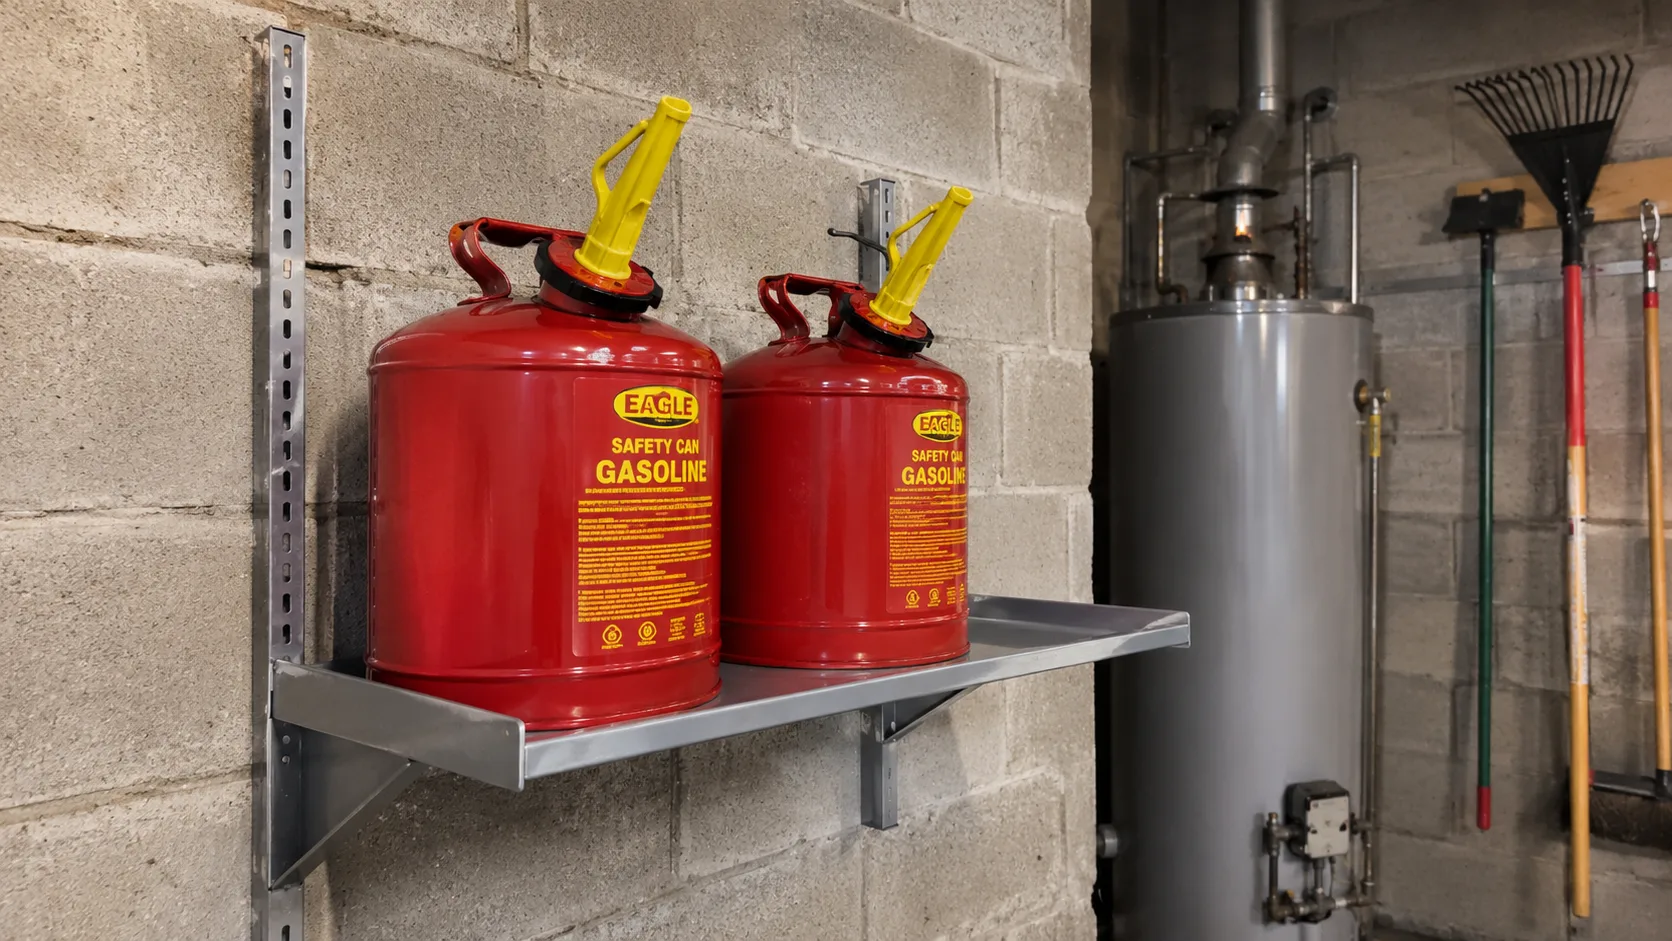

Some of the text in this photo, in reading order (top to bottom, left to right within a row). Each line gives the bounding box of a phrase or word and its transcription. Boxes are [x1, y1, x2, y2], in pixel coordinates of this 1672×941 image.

[624, 393, 693, 416] EAGLE
[920, 416, 960, 432] EAGLE
[611, 437, 699, 454] SAFETY CAN
[912, 449, 949, 462] SAFETY
[596, 459, 707, 484] GASOLINE
[901, 466, 966, 485] GASOLINE
